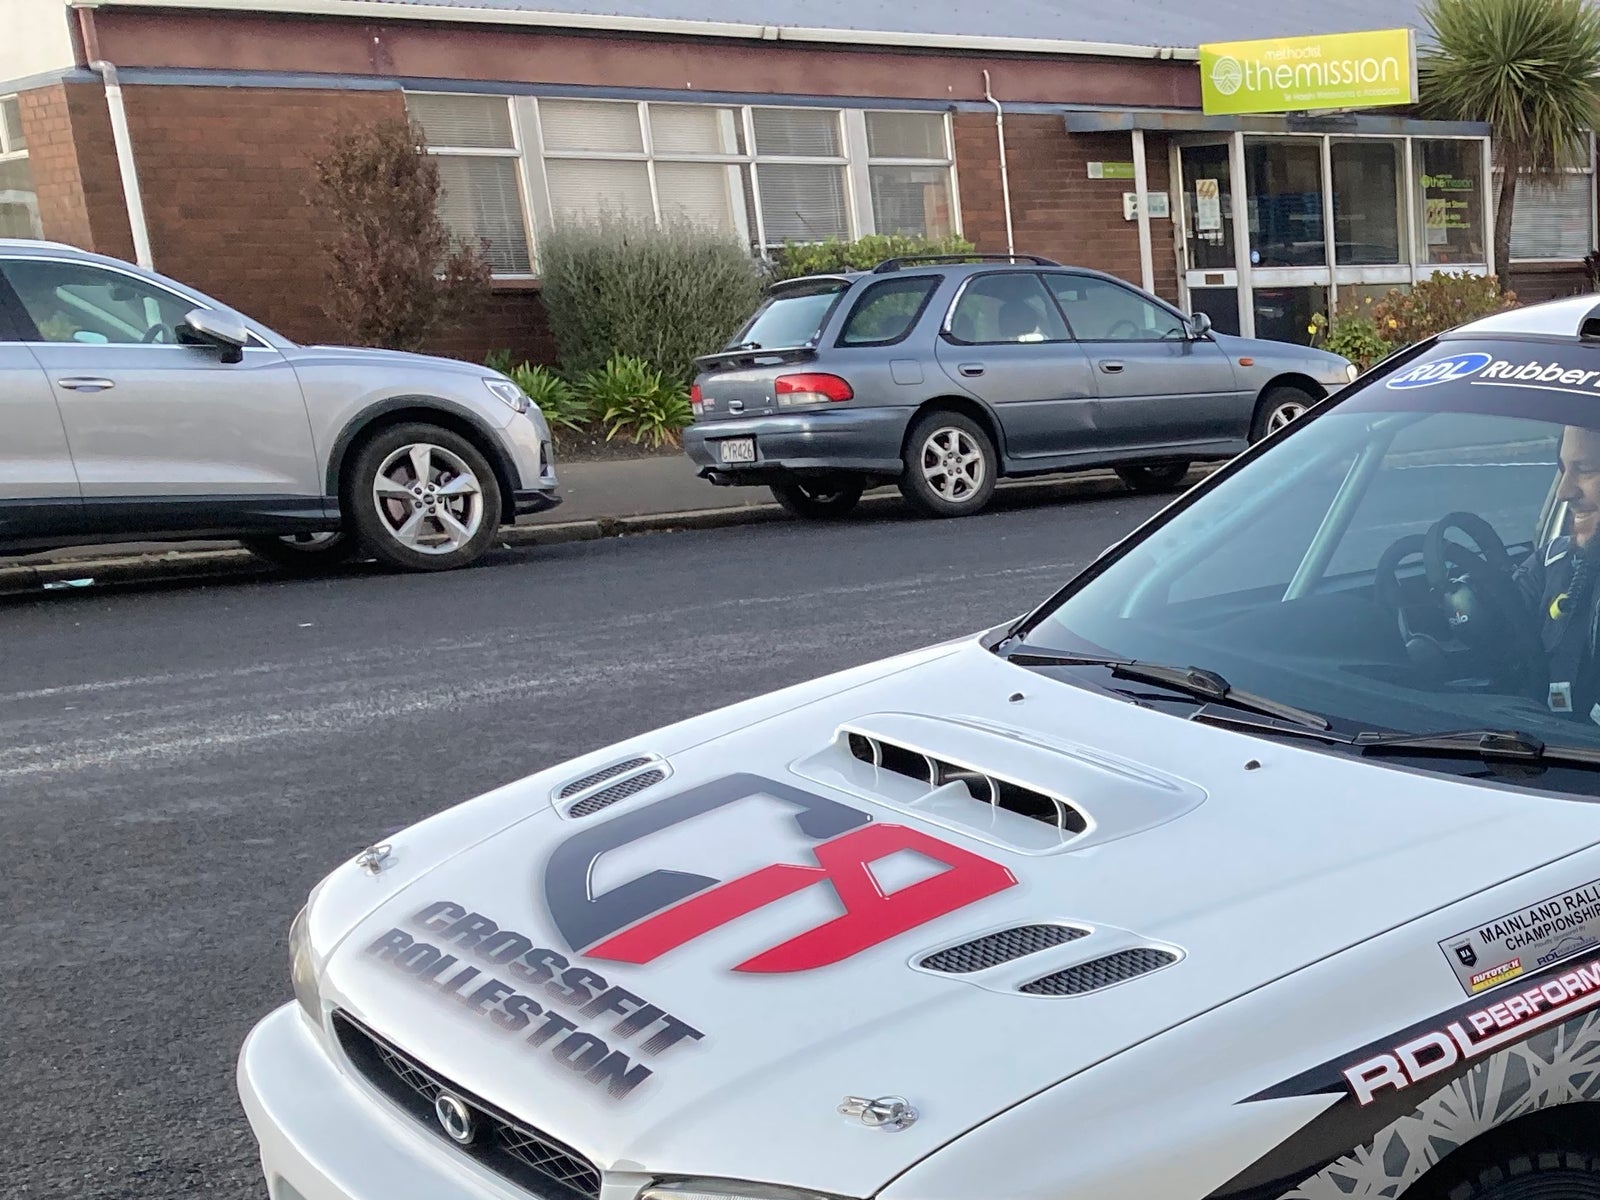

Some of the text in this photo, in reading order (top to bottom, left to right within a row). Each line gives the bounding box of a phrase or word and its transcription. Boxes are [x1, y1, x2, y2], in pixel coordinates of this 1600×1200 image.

[1390, 360, 1470, 384] RDL
[1479, 360, 1599, 383] Rubber
[722, 441, 754, 460] CYR426
[1479, 900, 1562, 945] MAINLAND
[409, 899, 708, 1059] CROSSFIT
[1536, 951, 1560, 966] RDL
[368, 926, 657, 1101] ROLLESTON
[1343, 1020, 1486, 1107] RDL
